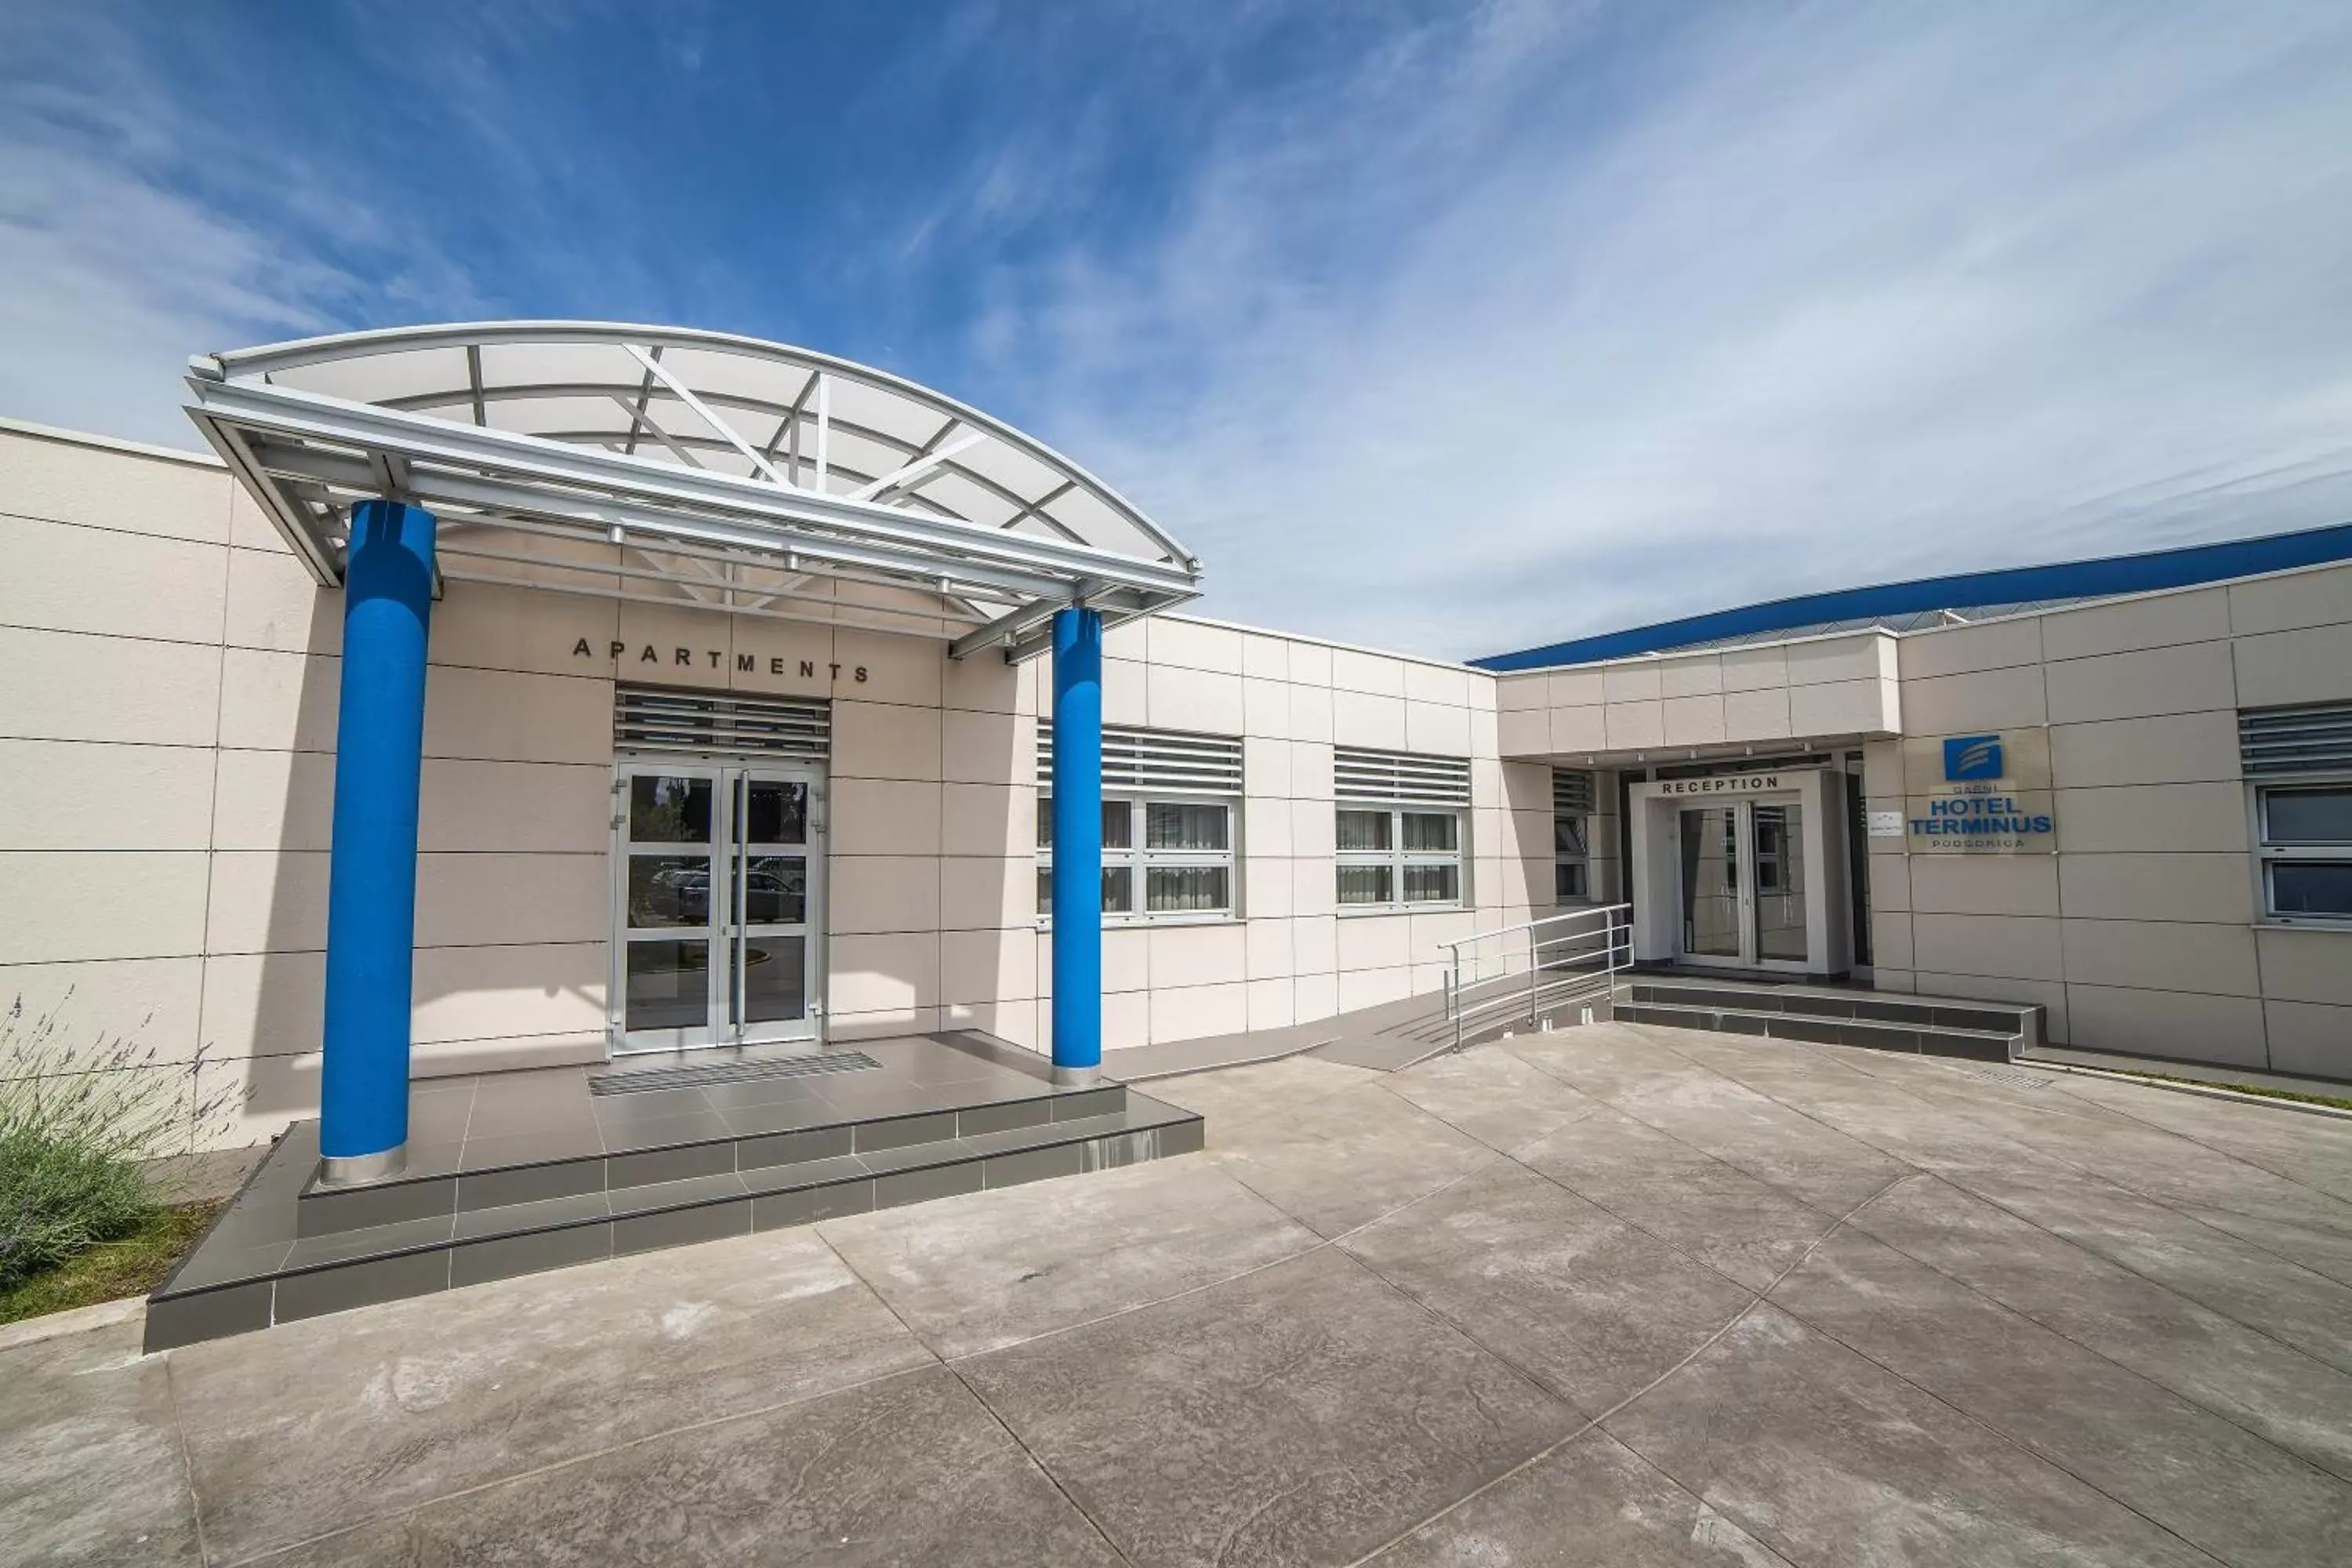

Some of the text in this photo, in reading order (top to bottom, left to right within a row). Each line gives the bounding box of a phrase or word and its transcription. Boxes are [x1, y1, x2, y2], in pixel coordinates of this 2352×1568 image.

[573, 637, 868, 683] APARTMENTS
[1662, 777, 1778, 793] RECEPTION
[1931, 797, 2022, 816] HOTEL
[1908, 815, 2052, 835] TERMINUS
